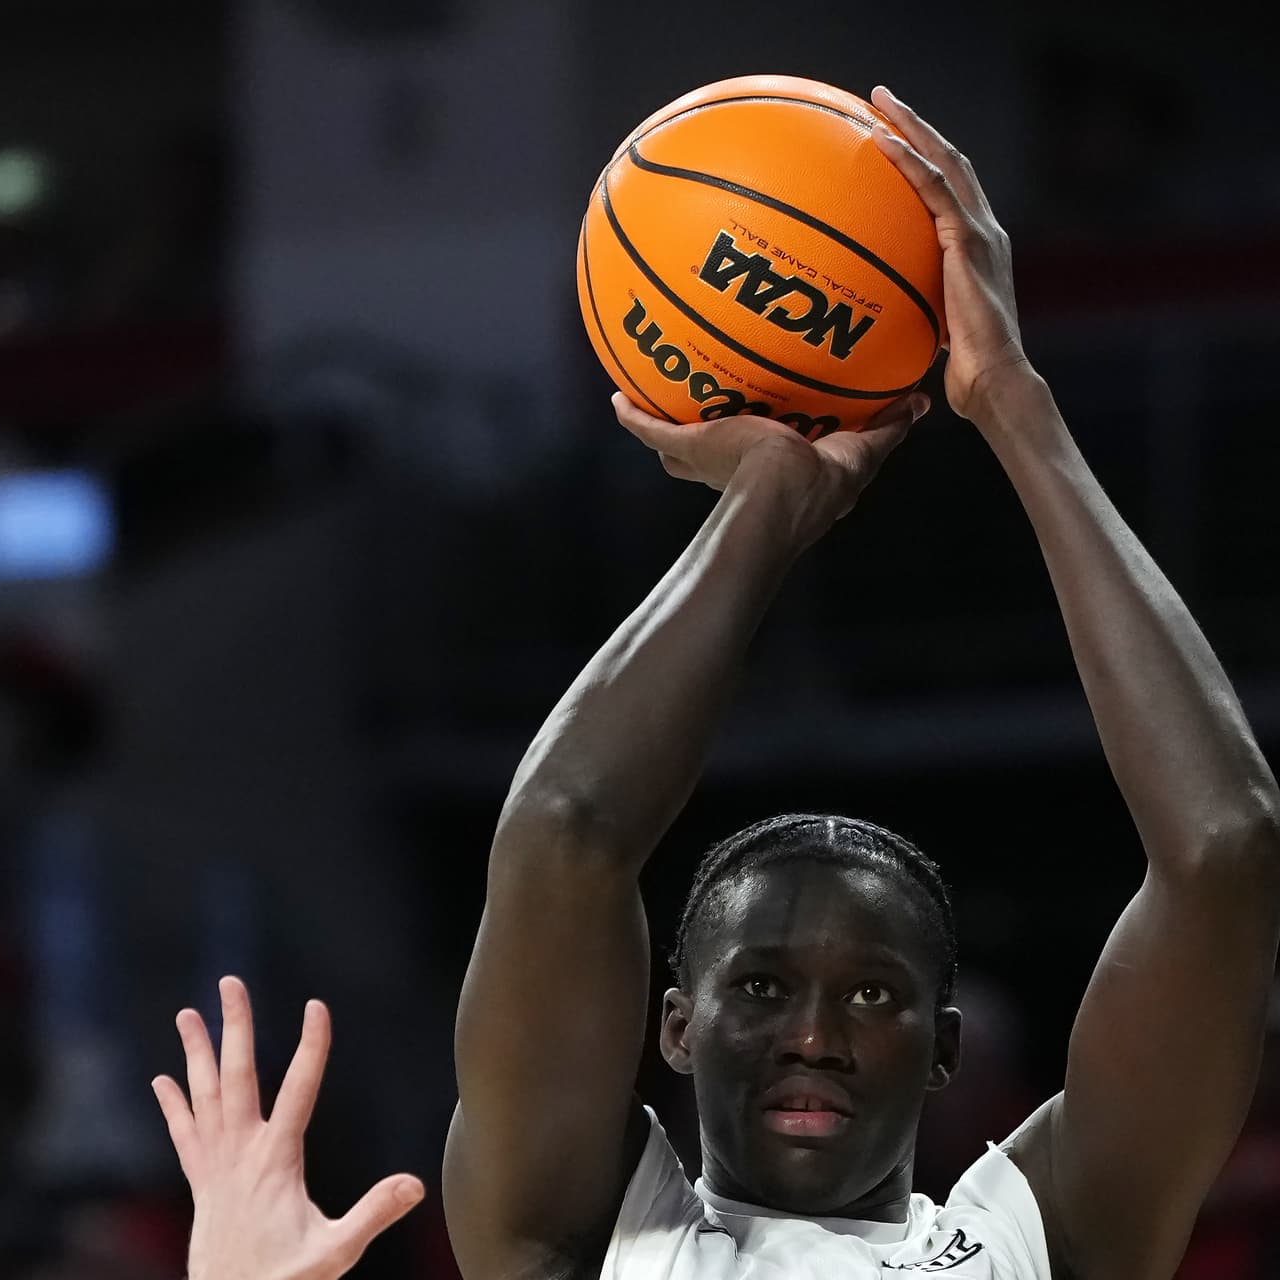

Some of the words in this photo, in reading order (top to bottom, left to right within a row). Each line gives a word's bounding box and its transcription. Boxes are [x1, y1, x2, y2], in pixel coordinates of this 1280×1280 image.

[729, 219, 768, 250] BALL
[771, 246, 817, 279] GAME
[698, 229, 877, 361] NCAA
[822, 275, 883, 314] OFFICIAL
[686, 341, 710, 362] BALL
[712, 362, 744, 384] GAME
